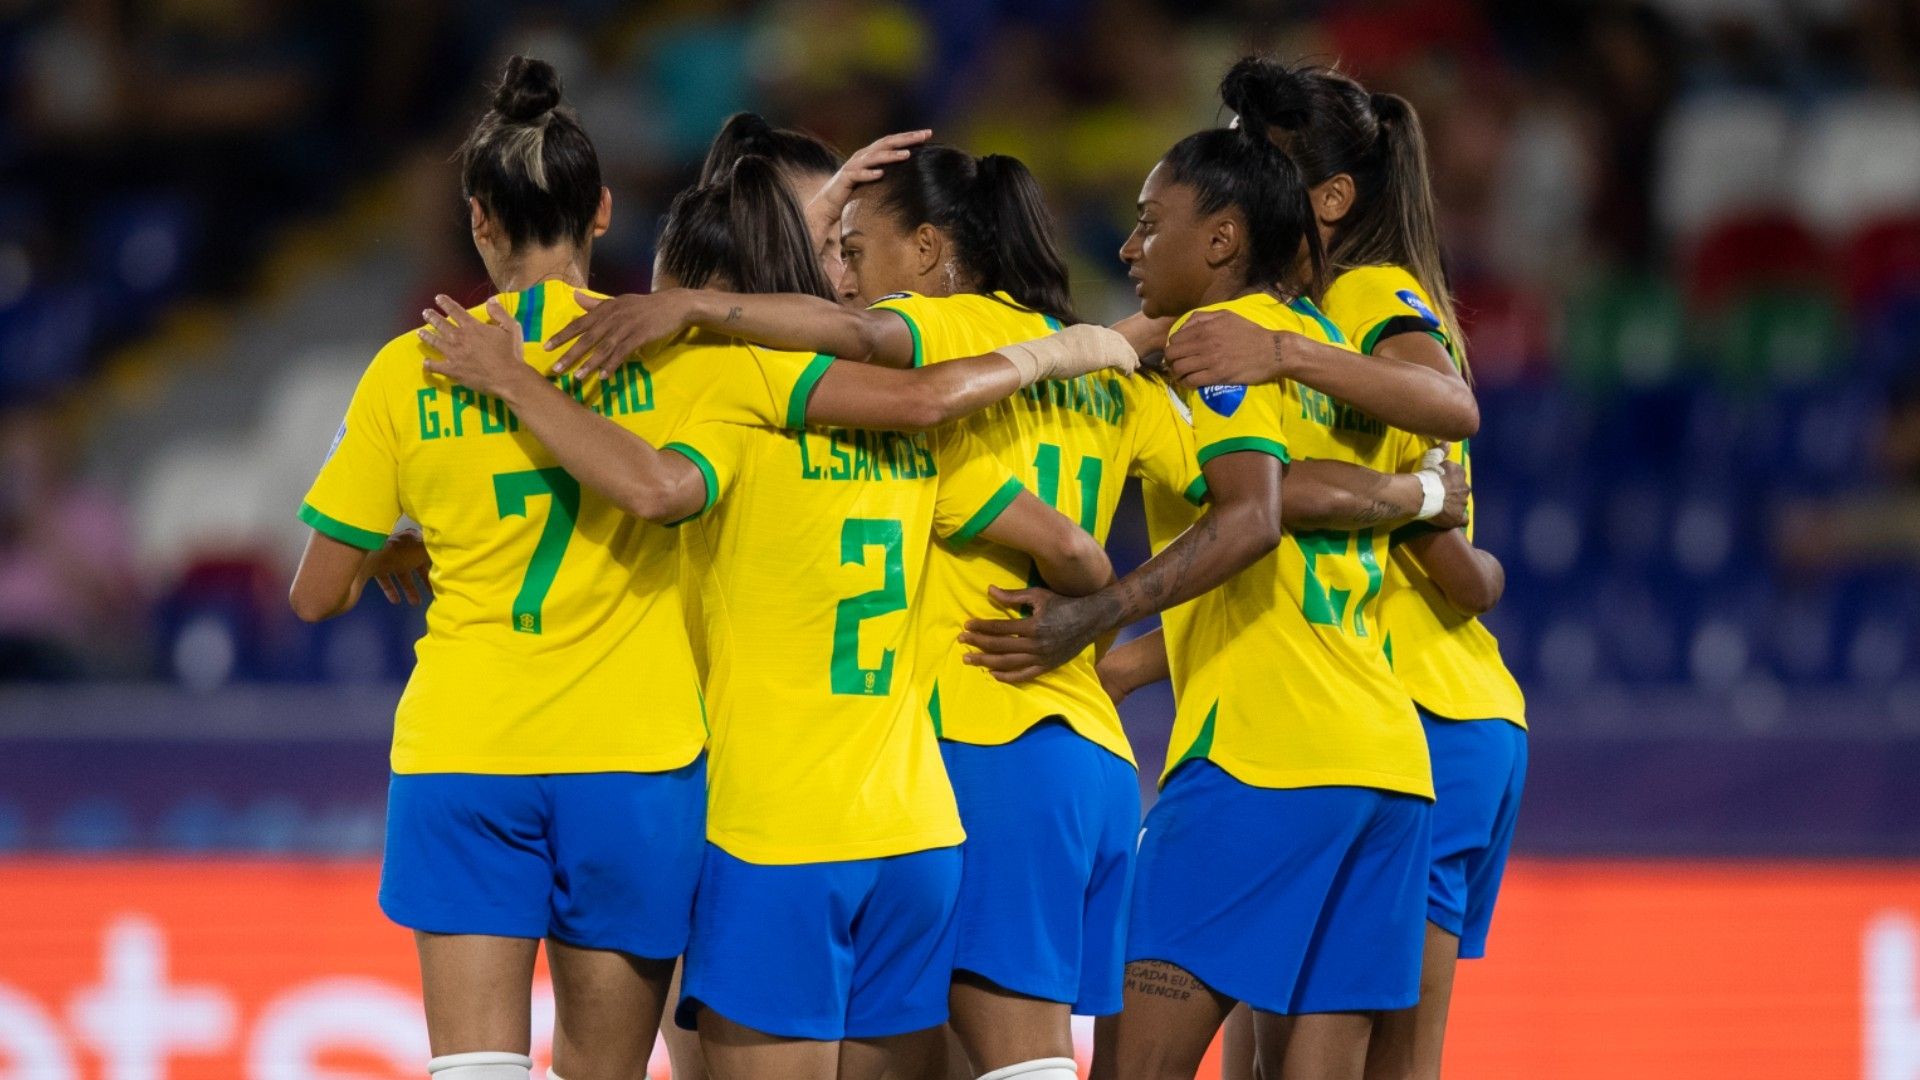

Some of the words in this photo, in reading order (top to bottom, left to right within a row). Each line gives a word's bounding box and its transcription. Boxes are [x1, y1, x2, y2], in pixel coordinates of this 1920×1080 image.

[493, 466, 581, 635] 7
[1032, 443, 1102, 538] 11
[830, 518, 908, 697] 2
[1140, 982, 1191, 1001] VENCER
